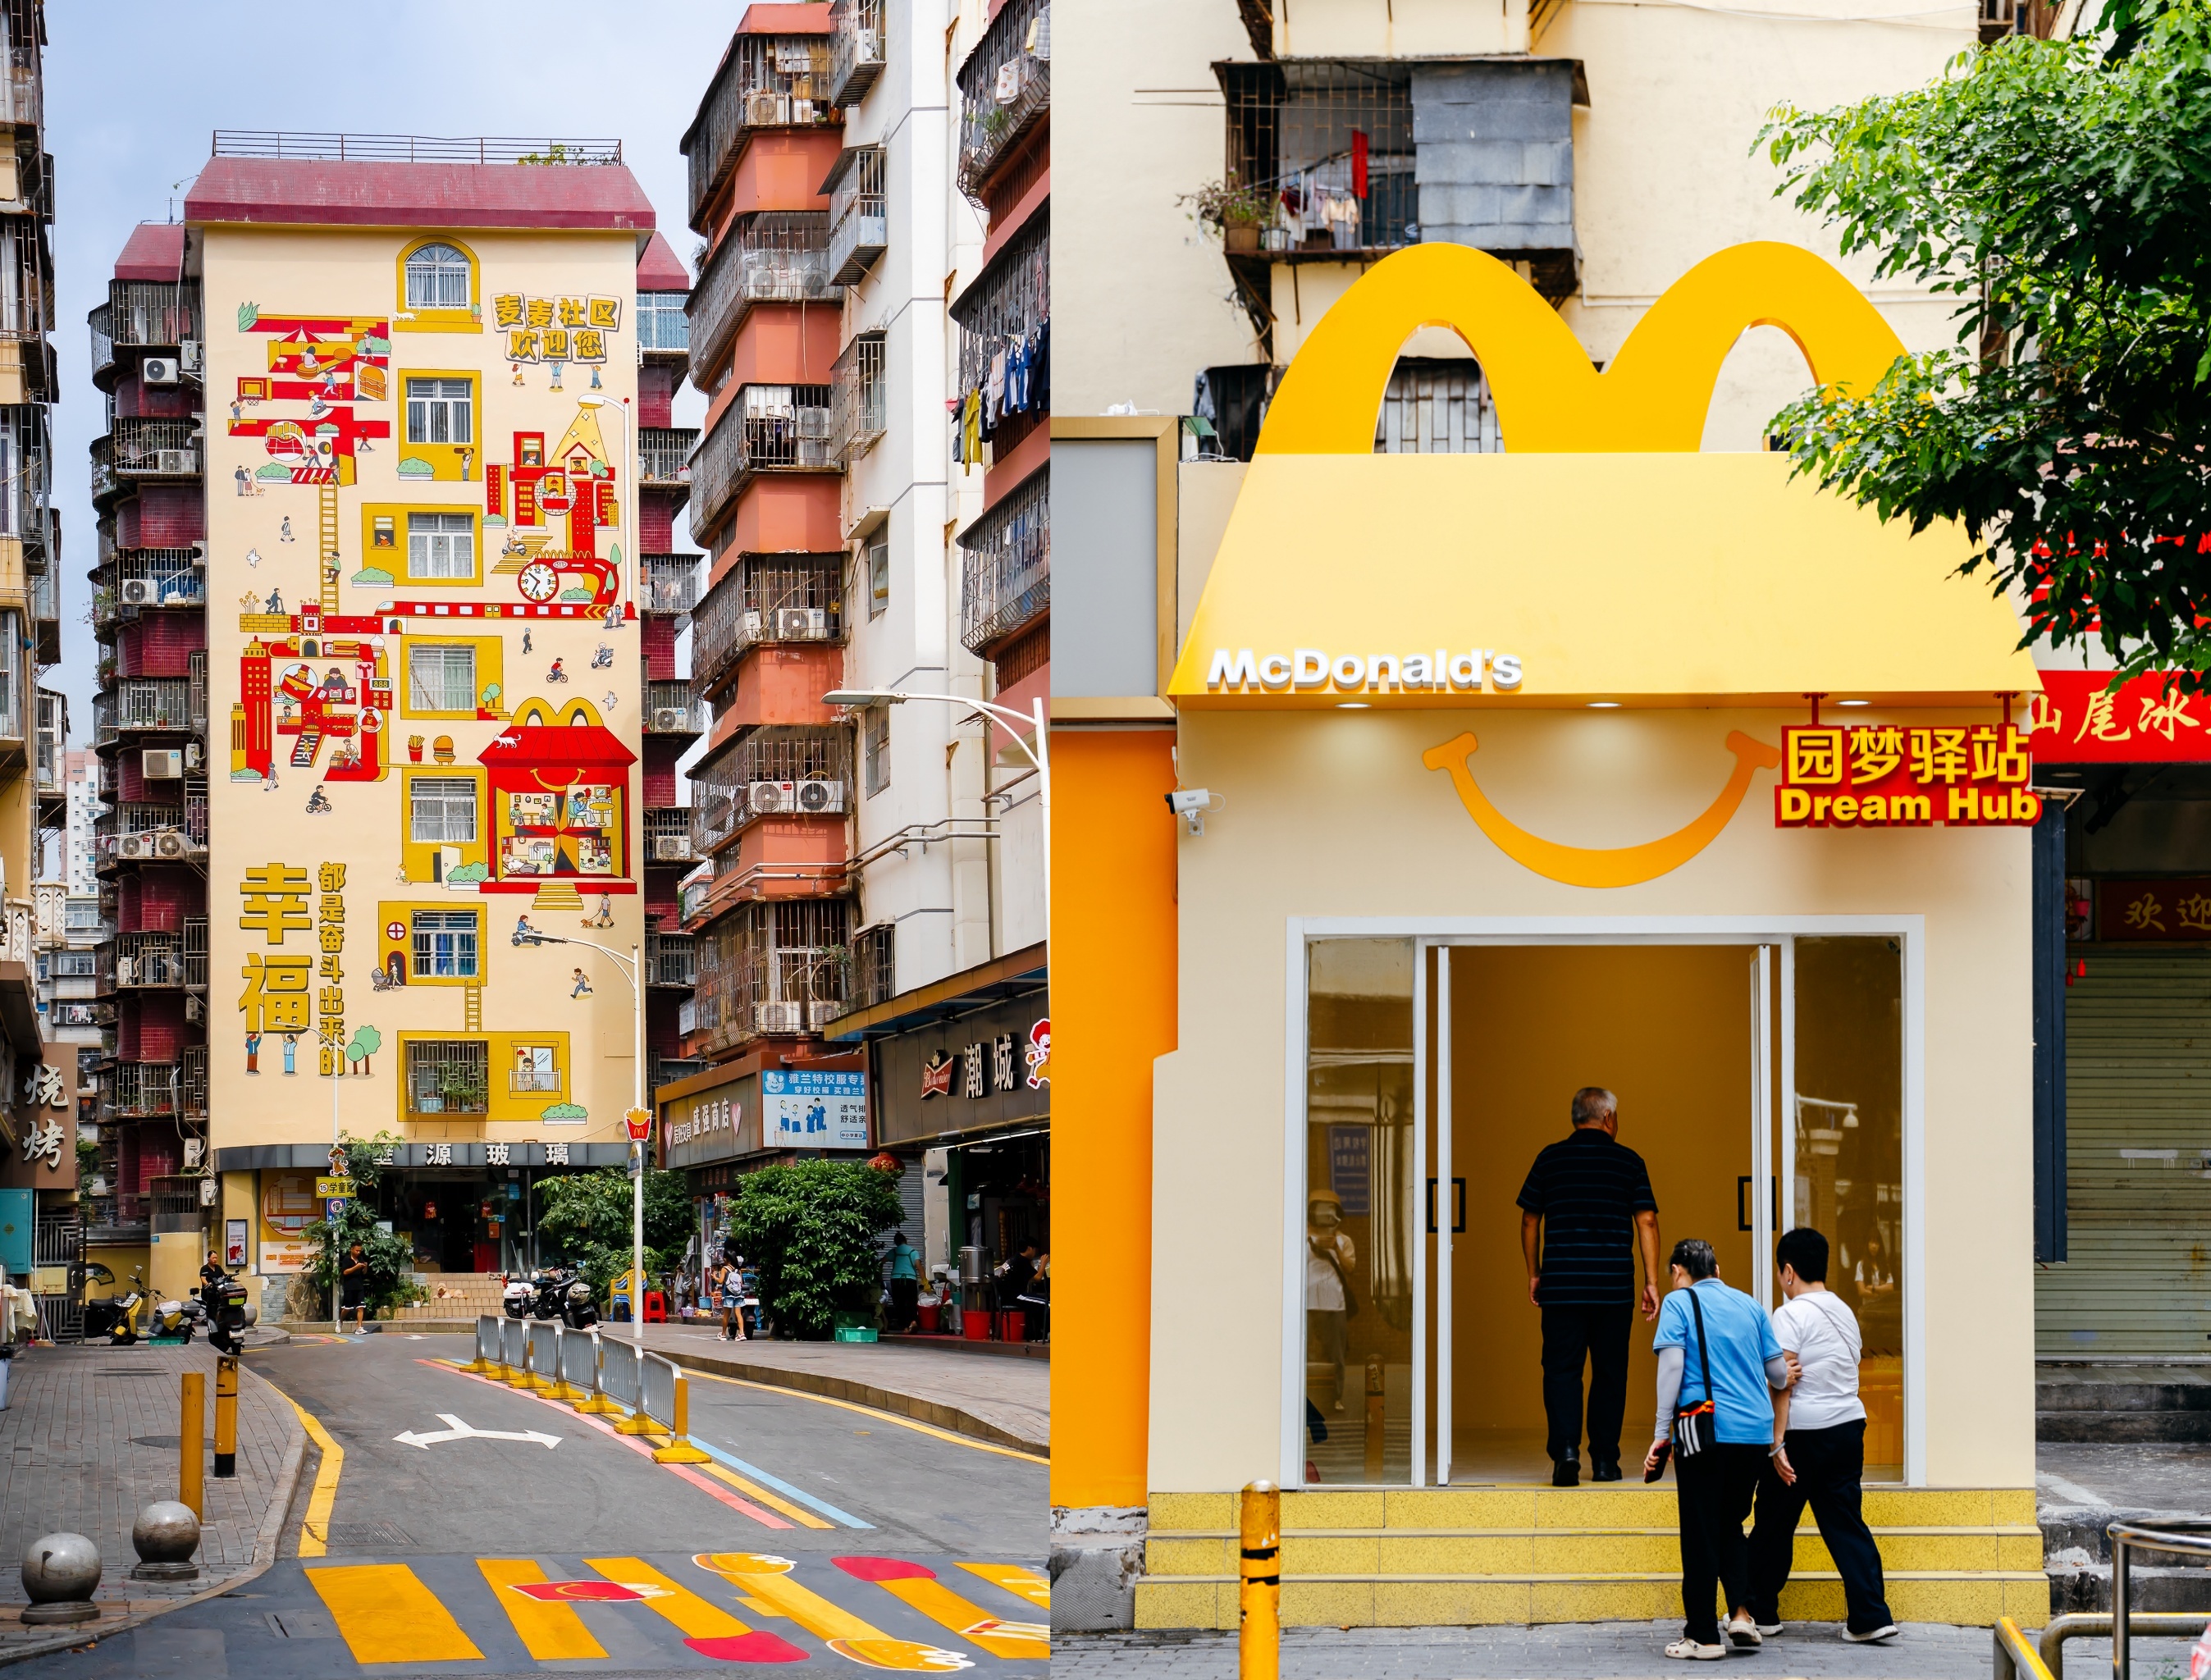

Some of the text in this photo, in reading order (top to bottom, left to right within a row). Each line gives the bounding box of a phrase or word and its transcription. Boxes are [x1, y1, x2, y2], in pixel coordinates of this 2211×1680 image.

[494, 294, 617, 329] 麦麦社区
[509, 328, 605, 361] 欢迎您
[1207, 648, 1523, 691] McDonald's
[2031, 687, 2211, 745] 山尾冰
[1788, 727, 2030, 785] 园梦驿站
[1780, 788, 2039, 820] Dream Hub
[2123, 892, 2211, 932] 欢迎
[317, 861, 346, 1077] 都是奋斗出来的
[965, 1033, 1039, 1099] 潮城
[794, 1085, 829, 1094] 穿好校服
[840, 1104, 866, 1113] 透气排
[22, 1063, 70, 1168] 烧烤
[693, 1098, 729, 1135] 盛强商店
[840, 1115, 866, 1124] 舒适亲
